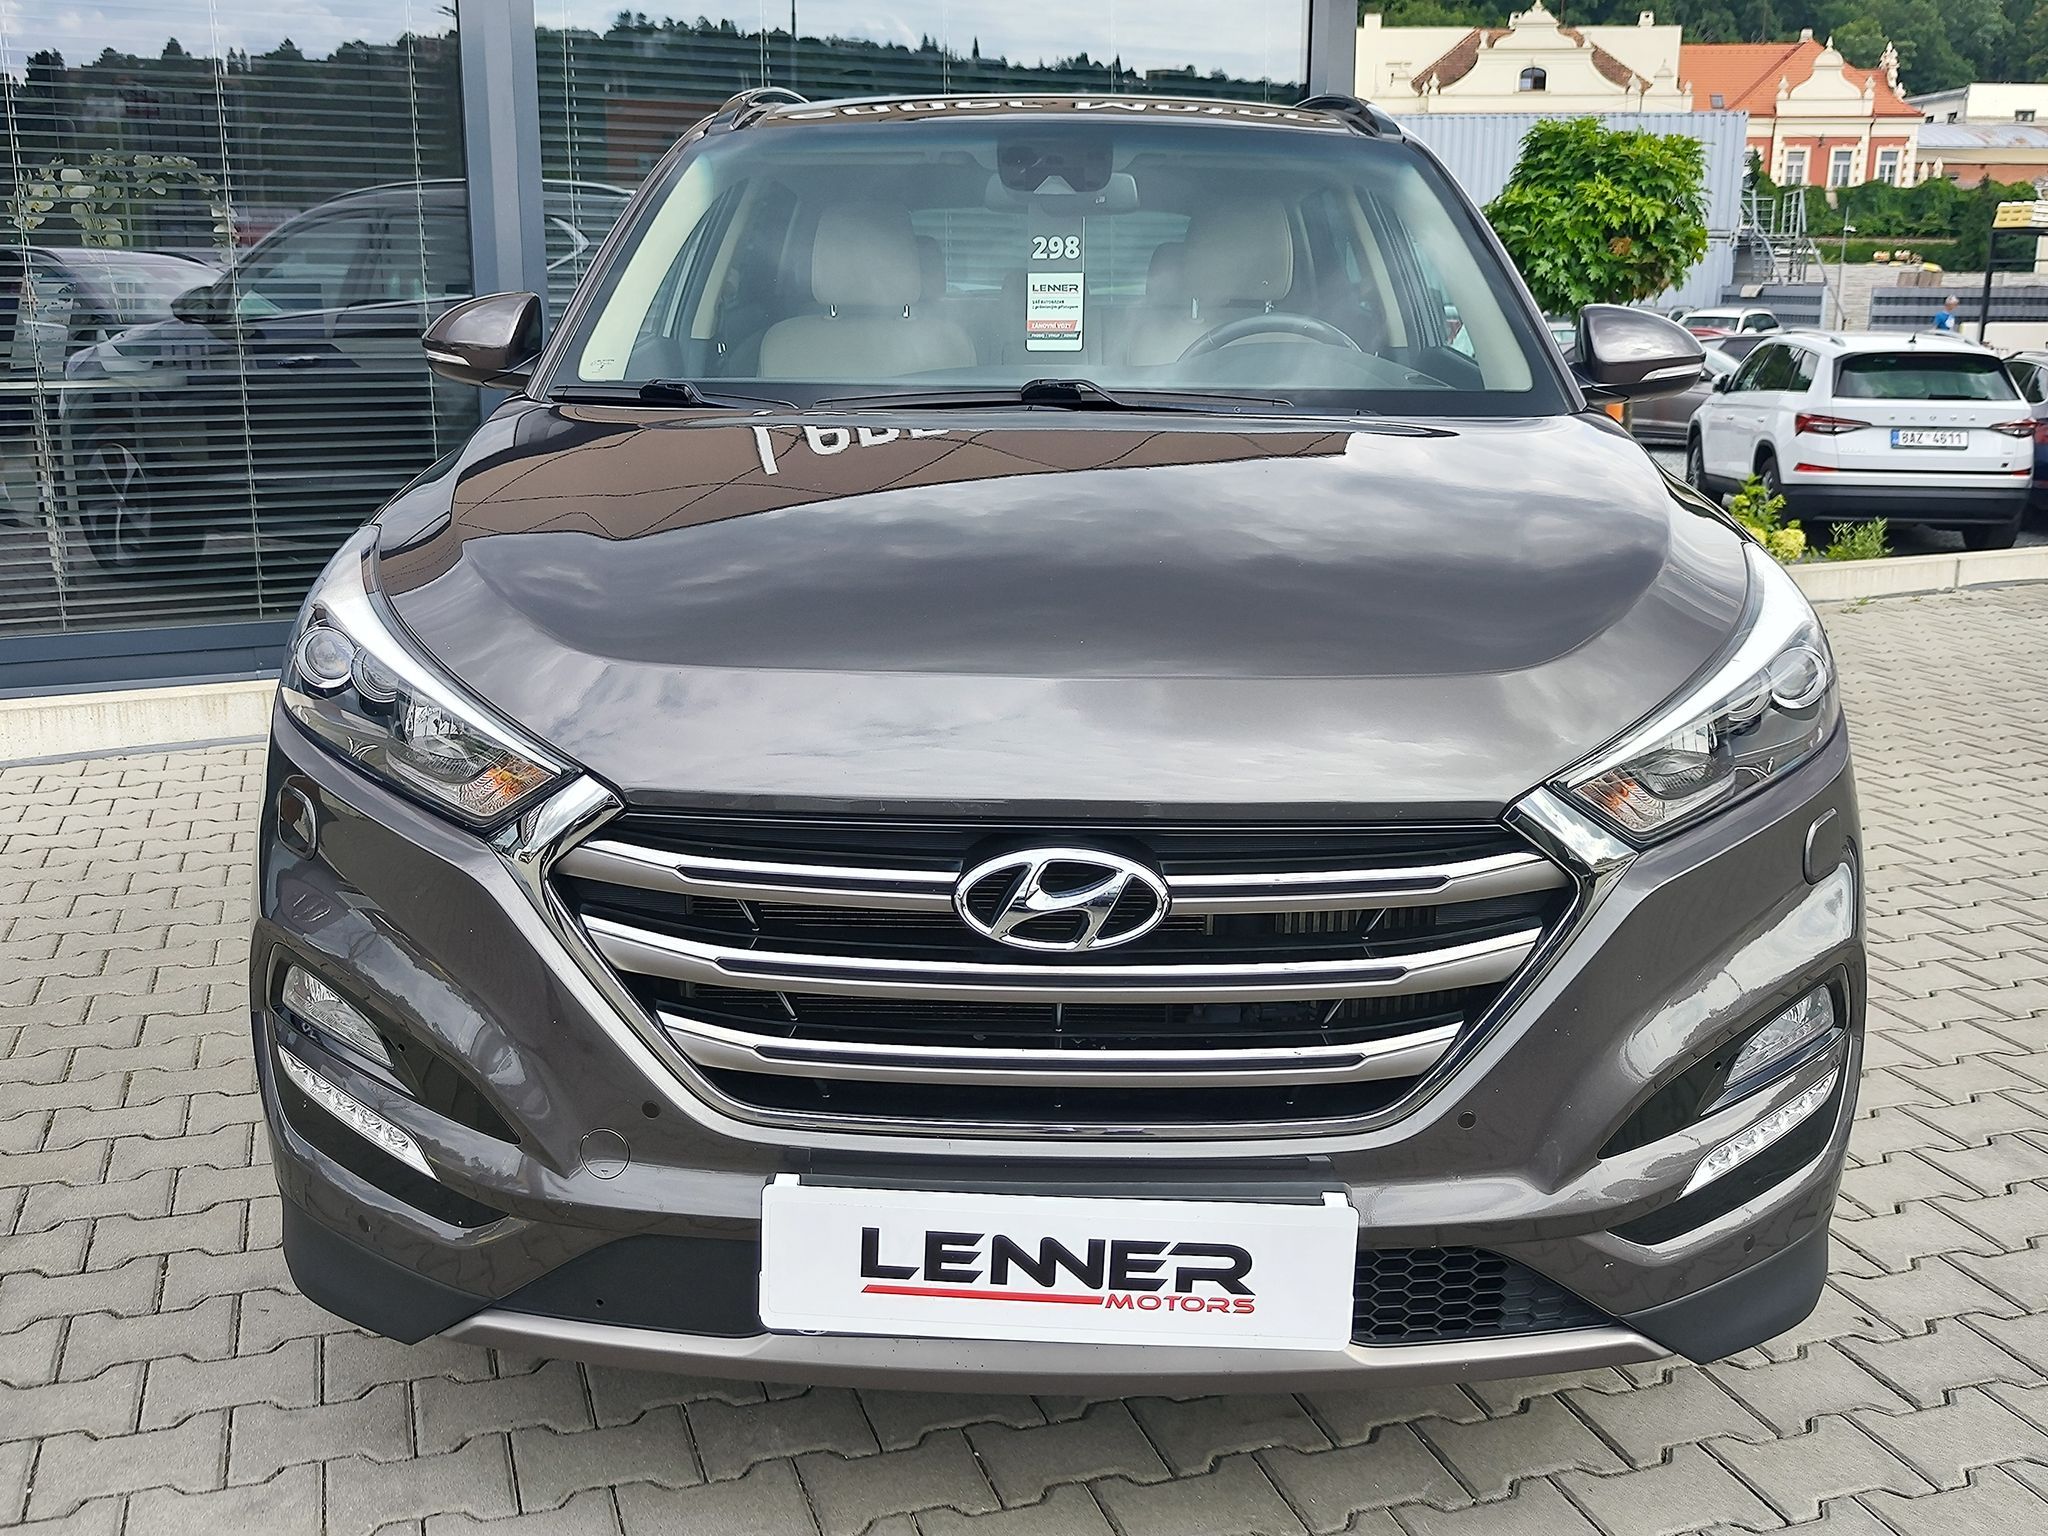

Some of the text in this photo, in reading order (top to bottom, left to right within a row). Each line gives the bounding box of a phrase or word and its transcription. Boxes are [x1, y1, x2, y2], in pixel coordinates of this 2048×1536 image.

[1031, 235, 1080, 260] 298
[1032, 284, 1079, 293] LENNER
[860, 1226, 1257, 1296] LENNER
[1104, 1292, 1256, 1315] MOTORS
